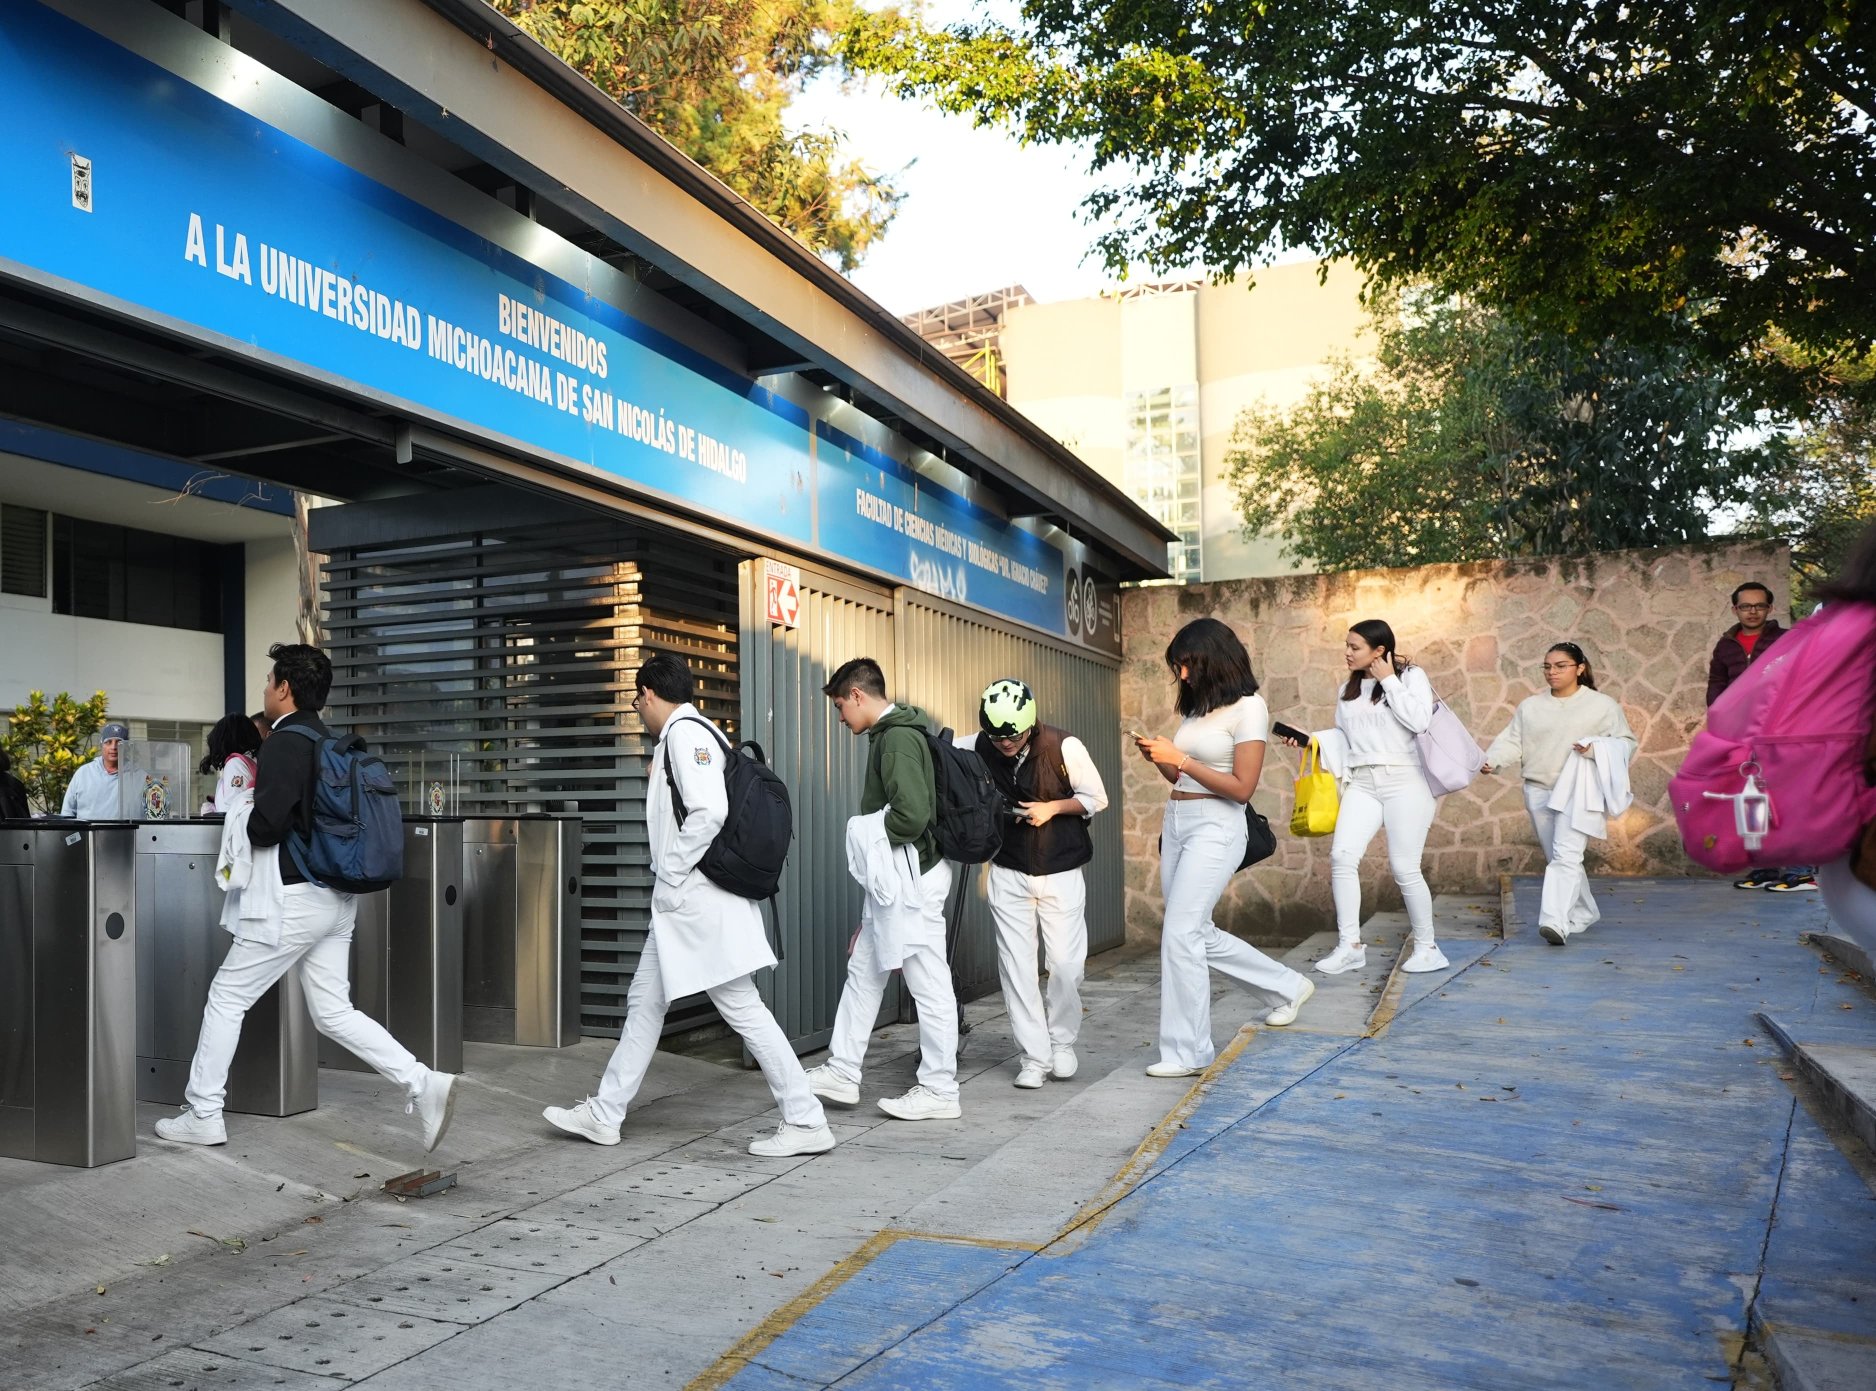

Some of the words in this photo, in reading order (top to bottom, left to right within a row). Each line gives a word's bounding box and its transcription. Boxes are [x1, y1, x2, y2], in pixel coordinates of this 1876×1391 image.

[184, 212, 207, 268] A
[216, 223, 252, 286] LA
[260, 243, 422, 350] UNIVERSIDAD
[428, 314, 553, 406] MICHOACANA
[556, 371, 579, 416] DE
[582, 384, 613, 431] SAN
[617, 407, 675, 454] NICOLÁS
[678, 424, 695, 462] DE
[698, 433, 747, 484] HIDALGO
[498, 293, 608, 379] BIENVENIDOS
[856, 487, 892, 528] FACULTAD
[893, 505, 903, 534] DE
[904, 511, 934, 547] CIENCIAS
[935, 522, 962, 558] MÉDICAS
[962, 537, 967, 561] Y
[765, 560, 791, 577] ENTRADA
